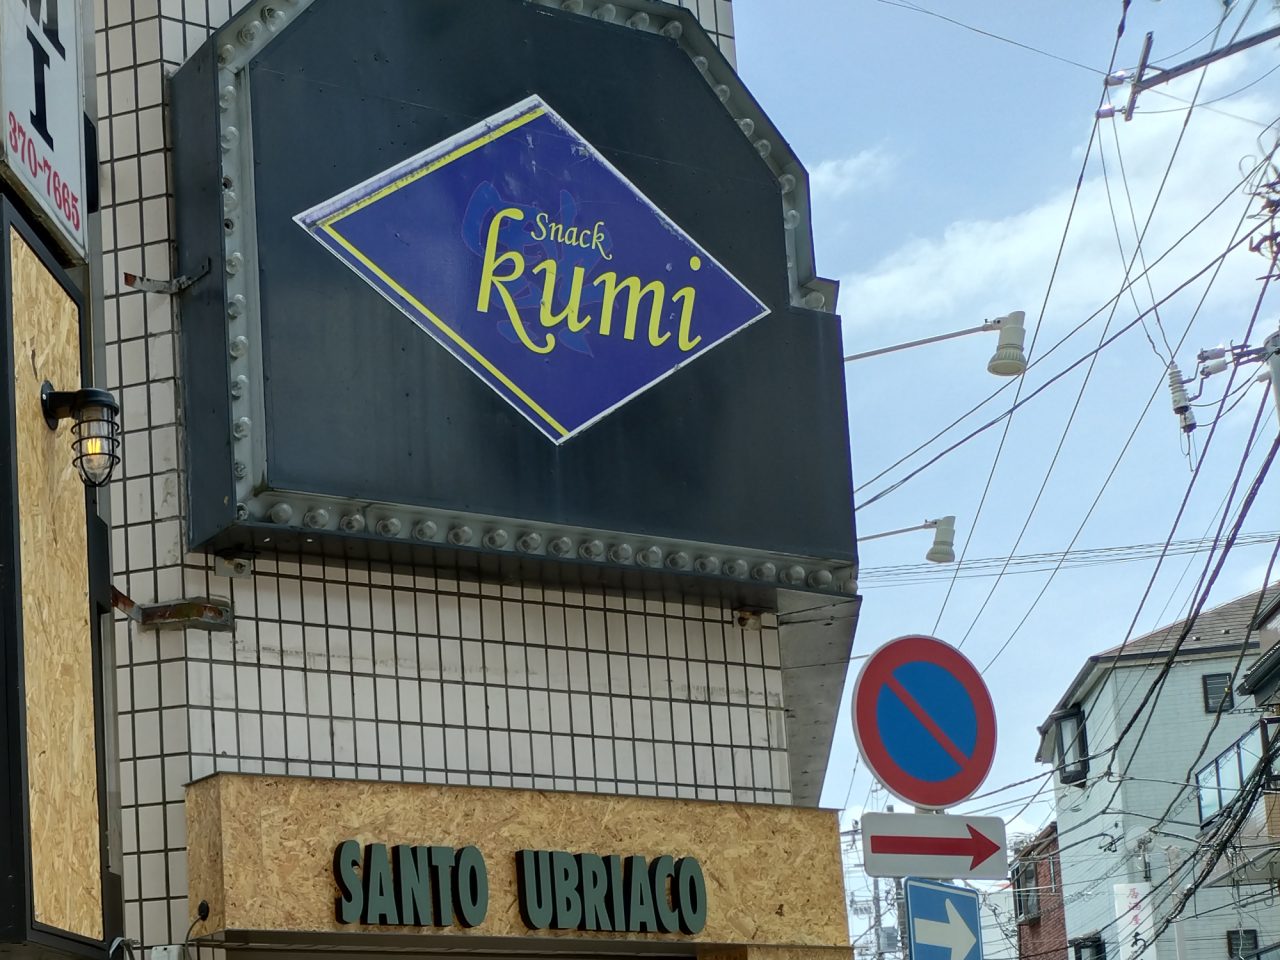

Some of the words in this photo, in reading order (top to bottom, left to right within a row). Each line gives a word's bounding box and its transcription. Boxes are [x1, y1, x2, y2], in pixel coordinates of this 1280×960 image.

[8, 111, 81, 232] 370-7665
[530, 212, 614, 260] Snack
[334, 840, 489, 928] SANTO
[516, 849, 708, 935] UBRIACO
